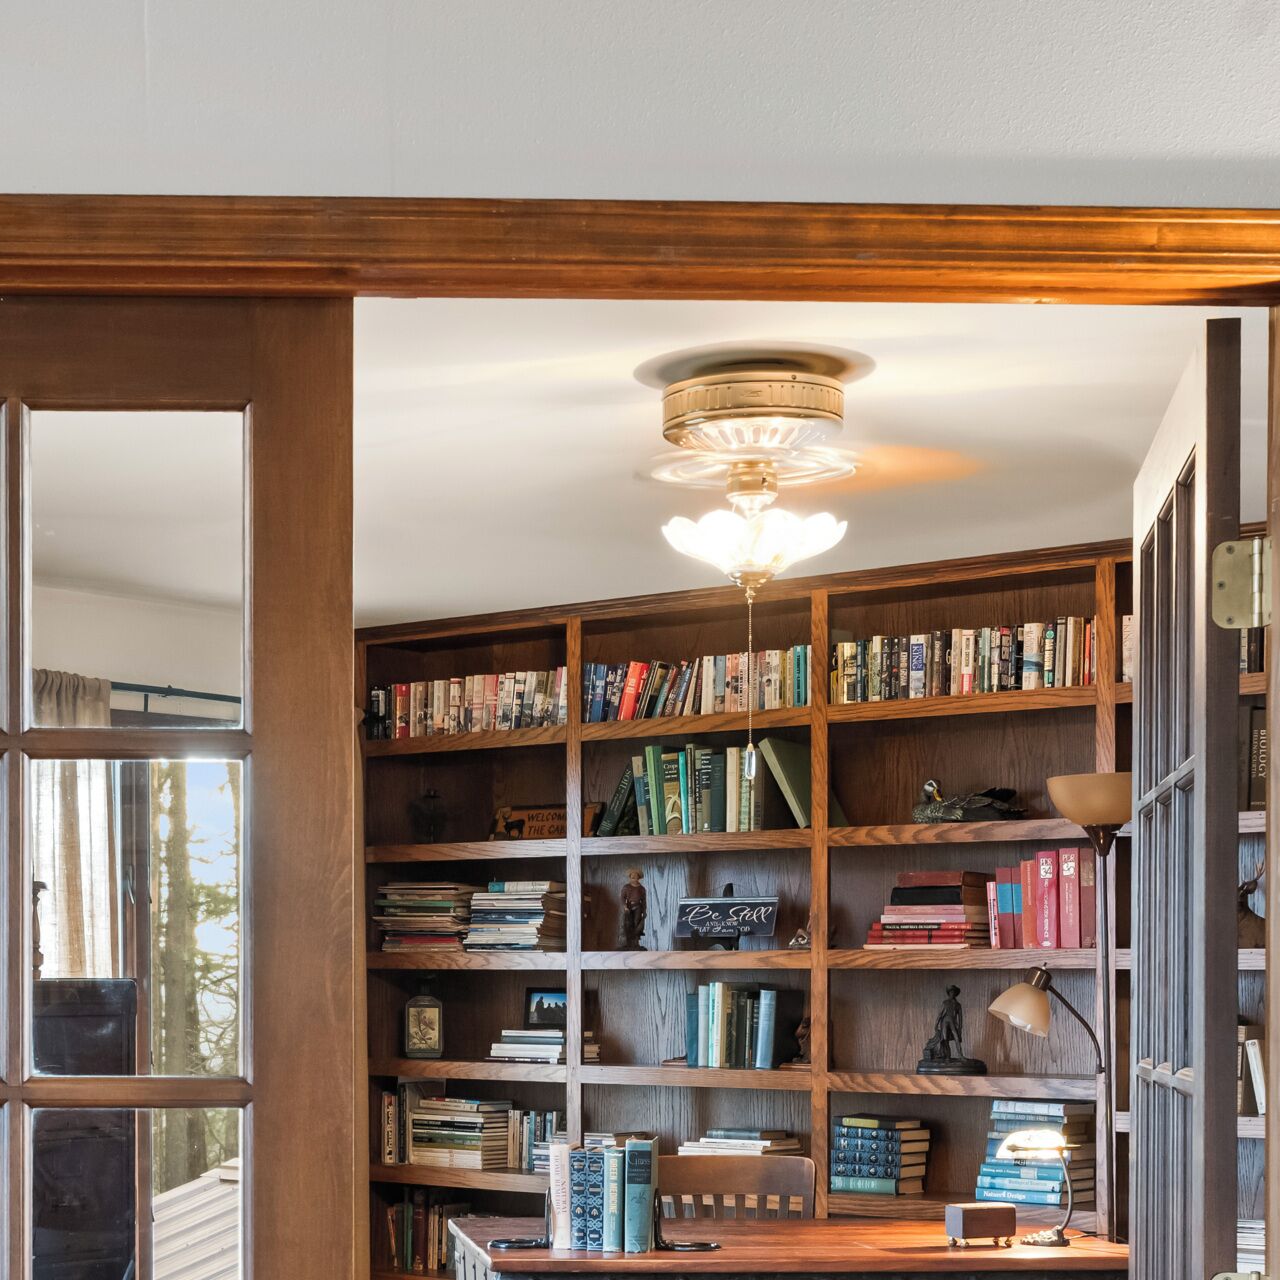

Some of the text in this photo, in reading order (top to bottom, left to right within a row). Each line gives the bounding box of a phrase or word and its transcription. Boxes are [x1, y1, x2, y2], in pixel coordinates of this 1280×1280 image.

[1258, 729, 1267, 778] BIOLOGY
[527, 812, 567, 822] WELCOM
[528, 825, 545, 836] THE
[681, 904, 773, 927] Be Still
[610, 1158, 618, 1180] GREEN
[560, 1181, 568, 1214] NATURAL
[609, 1182, 618, 1215] MEDICINE
